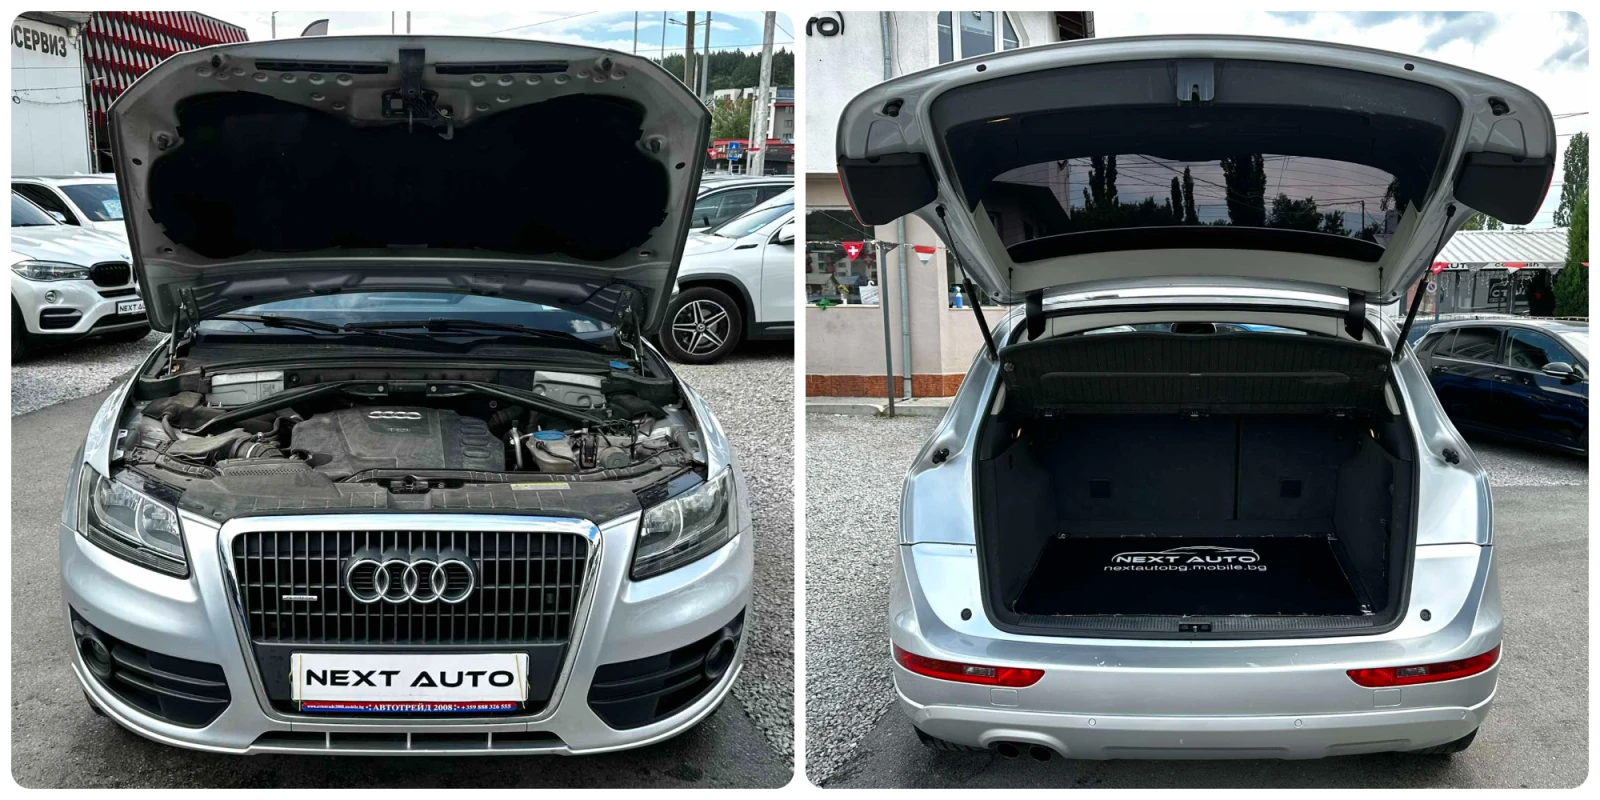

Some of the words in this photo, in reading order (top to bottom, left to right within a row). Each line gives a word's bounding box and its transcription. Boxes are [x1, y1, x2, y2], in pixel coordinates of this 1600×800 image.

[11, 25, 67, 57] СЕРВИЗ
[120, 303, 137, 312] NEXT
[1104, 564, 1267, 572] nextautobg.mobile.bg
[306, 669, 400, 686] NEXT
[410, 671, 514, 687] AUTO
[373, 703, 431, 712] АВТОТРЕЙД
